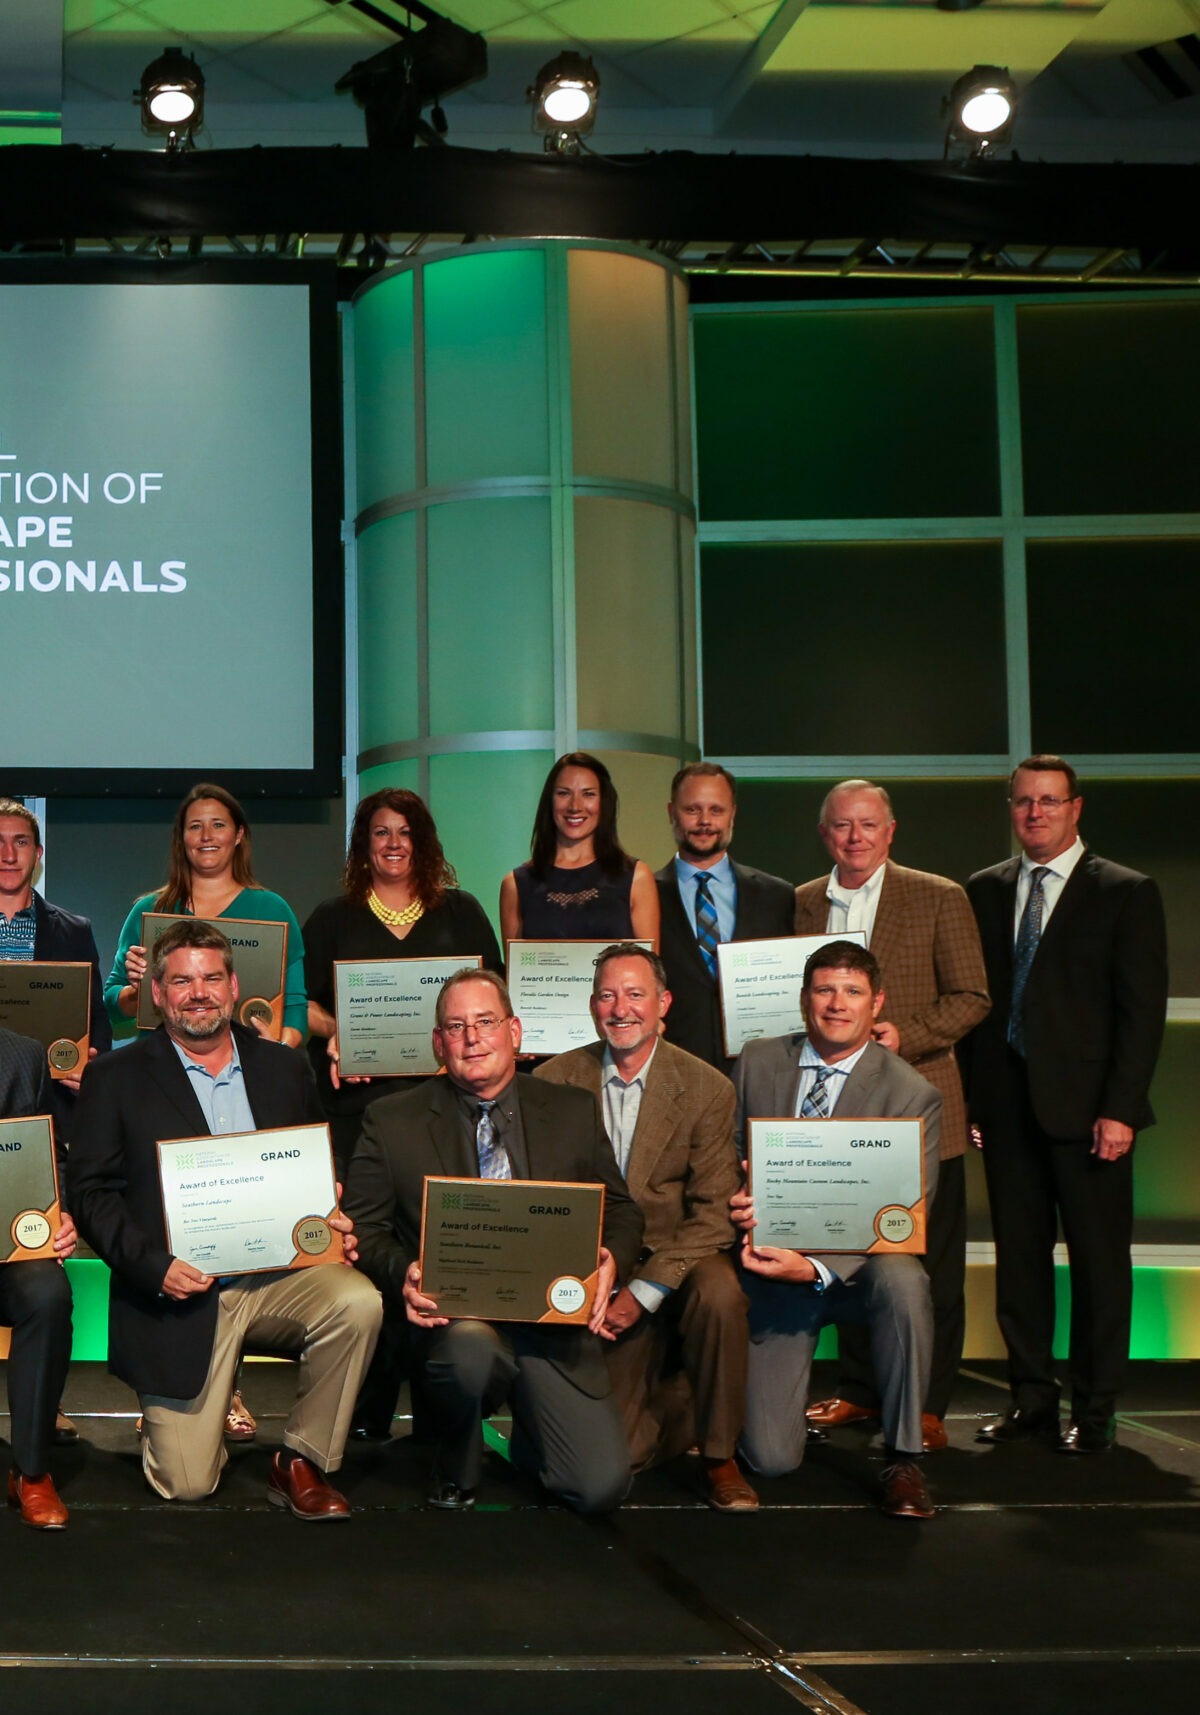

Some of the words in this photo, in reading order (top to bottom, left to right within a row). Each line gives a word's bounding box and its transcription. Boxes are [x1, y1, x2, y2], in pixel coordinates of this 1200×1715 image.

[102, 472, 164, 504] OF
[850, 1140, 891, 1148] GRAND
[261, 1150, 300, 1161] GRAND
[180, 1181, 206, 1190] Award
[220, 1175, 264, 1186] Excellence
[529, 1205, 570, 1216] GRAND
[24, 1224, 42, 1232] 2017
[441, 1222, 468, 1230] Award
[483, 1224, 528, 1233] Excellence
[305, 1230, 324, 1239] 2017
